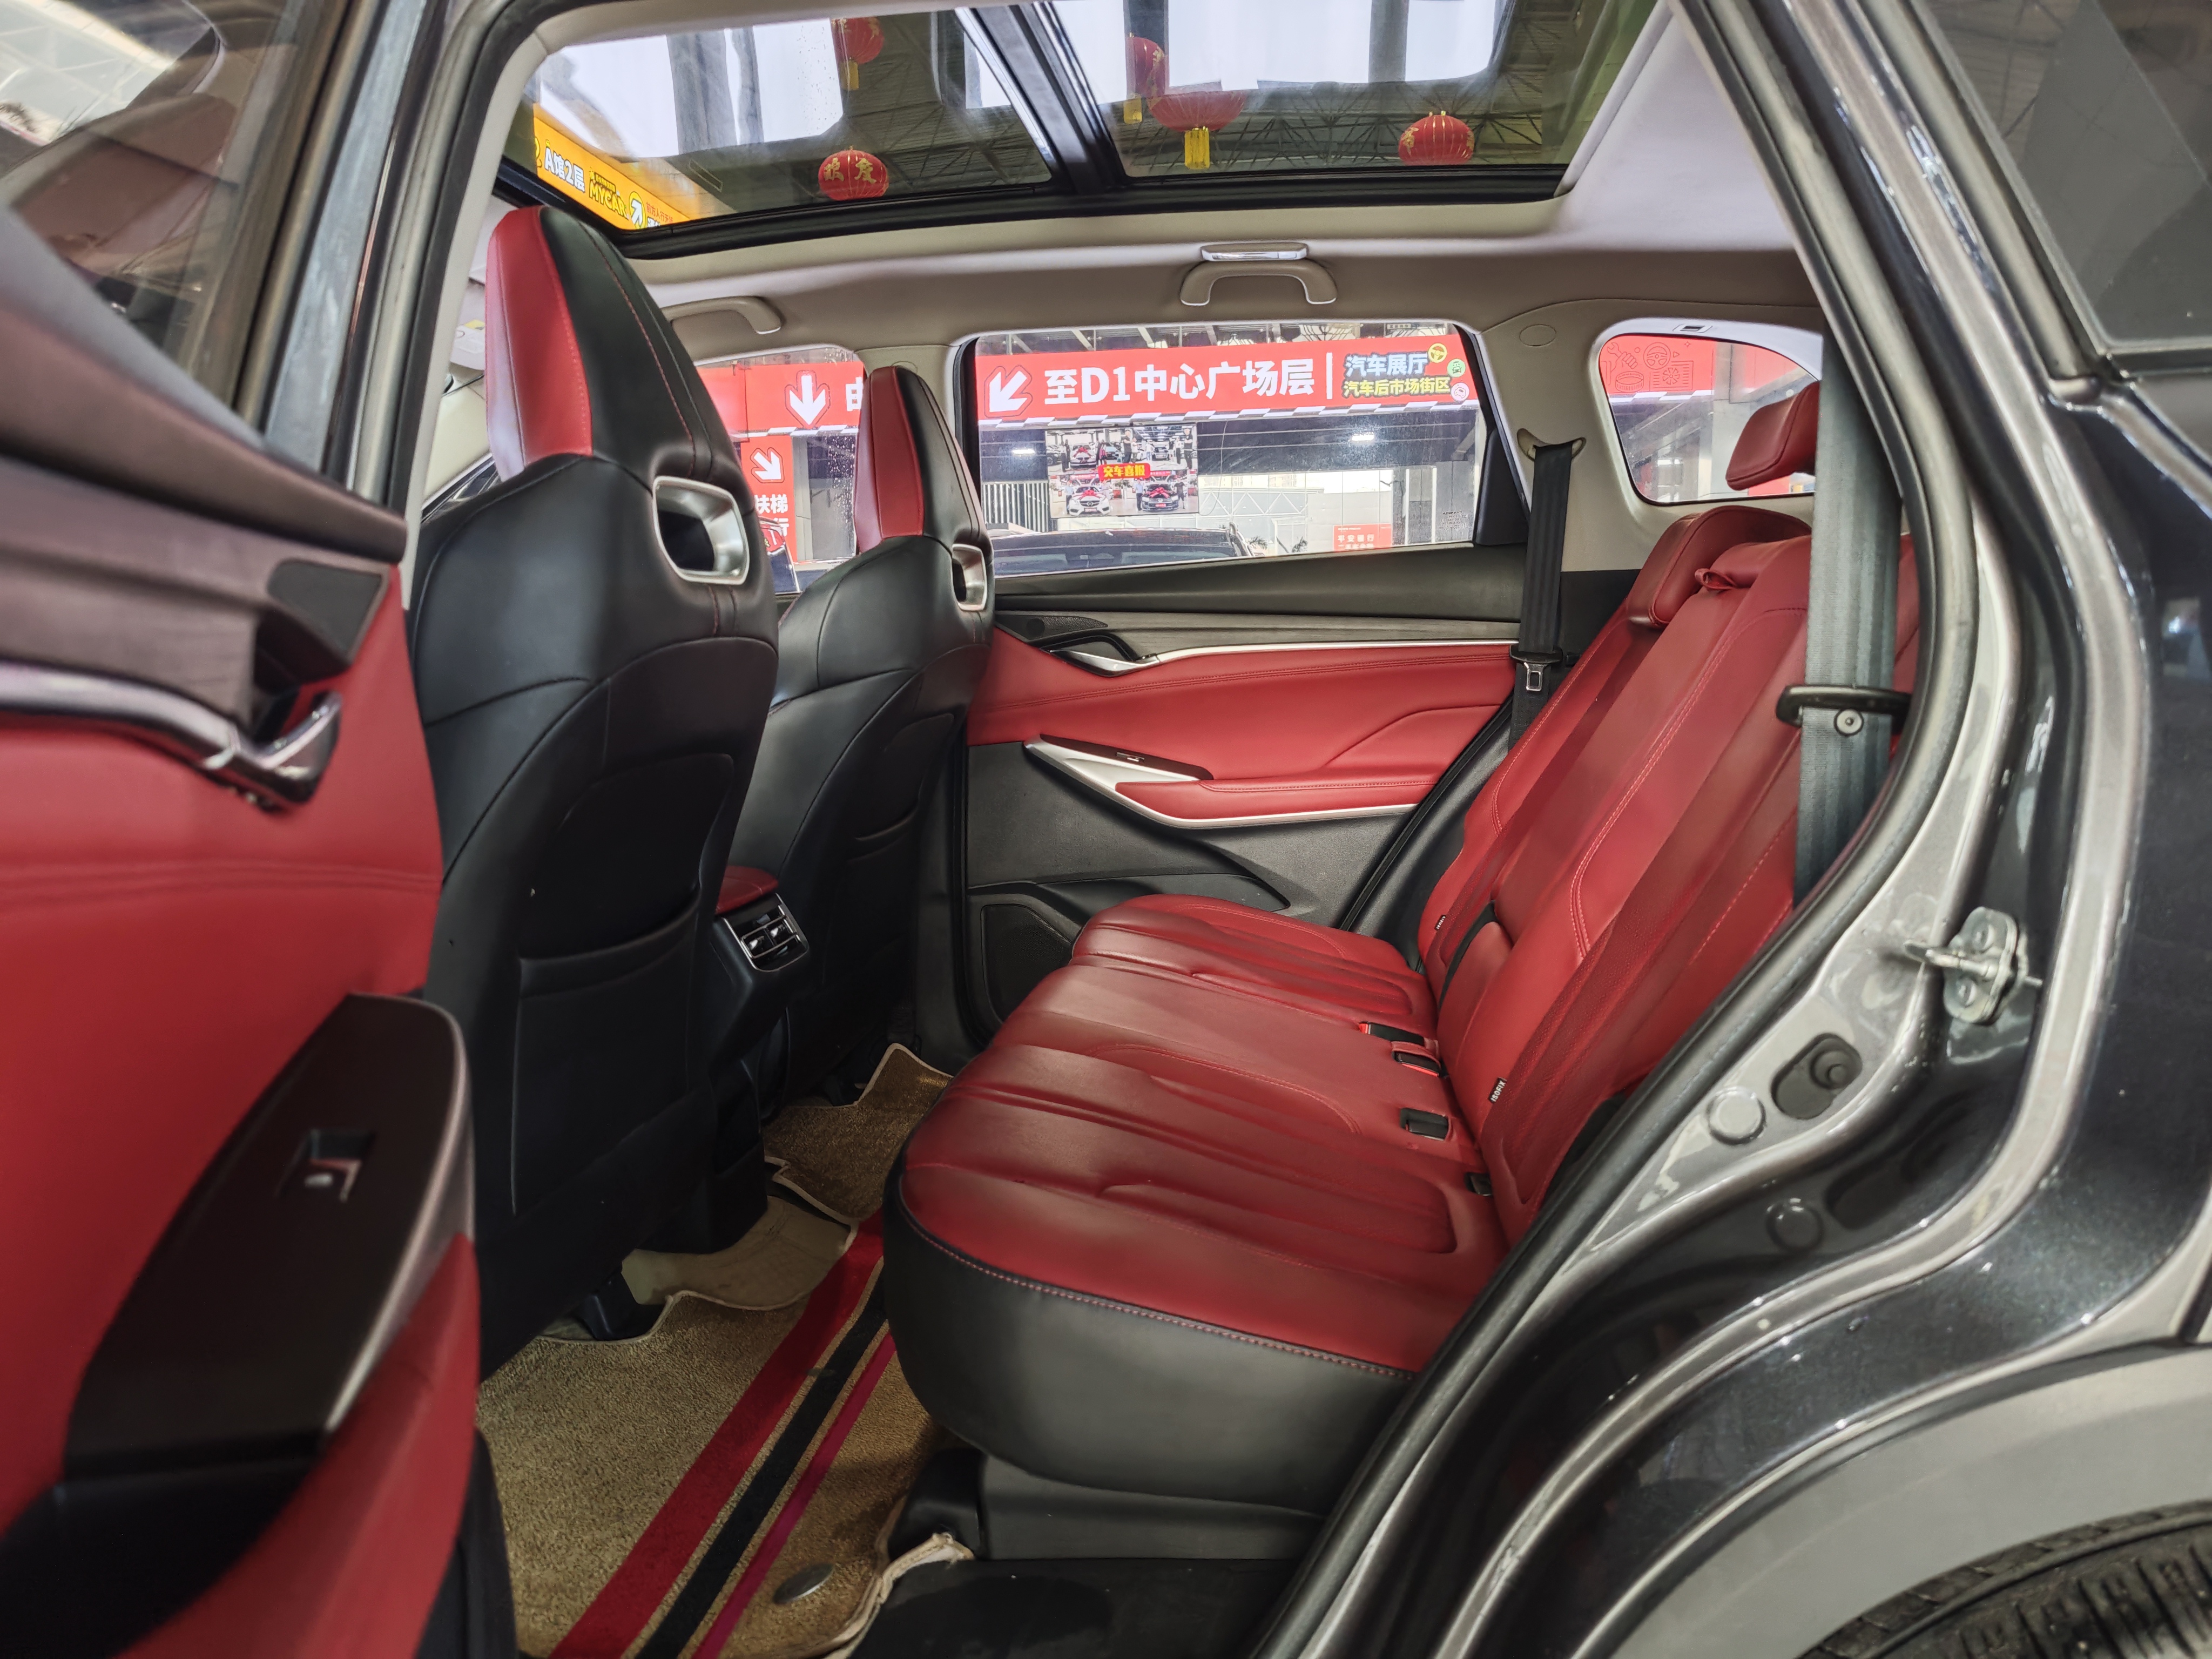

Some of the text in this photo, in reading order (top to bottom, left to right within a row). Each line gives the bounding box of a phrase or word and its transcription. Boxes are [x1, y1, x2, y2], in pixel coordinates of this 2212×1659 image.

[544, 146, 585, 193] A馆2层
[589, 179, 629, 220] MYCAR
[1345, 353, 1428, 377] 汽车展厅
[1044, 359, 1314, 405] 至D1中心广场层
[1343, 377, 1451, 399] 汽车后市场街区
[1103, 464, 1145, 477] 交车喜报
[754, 494, 788, 514] 扶梯
[1491, 1080, 1506, 1102] ISOFIX
